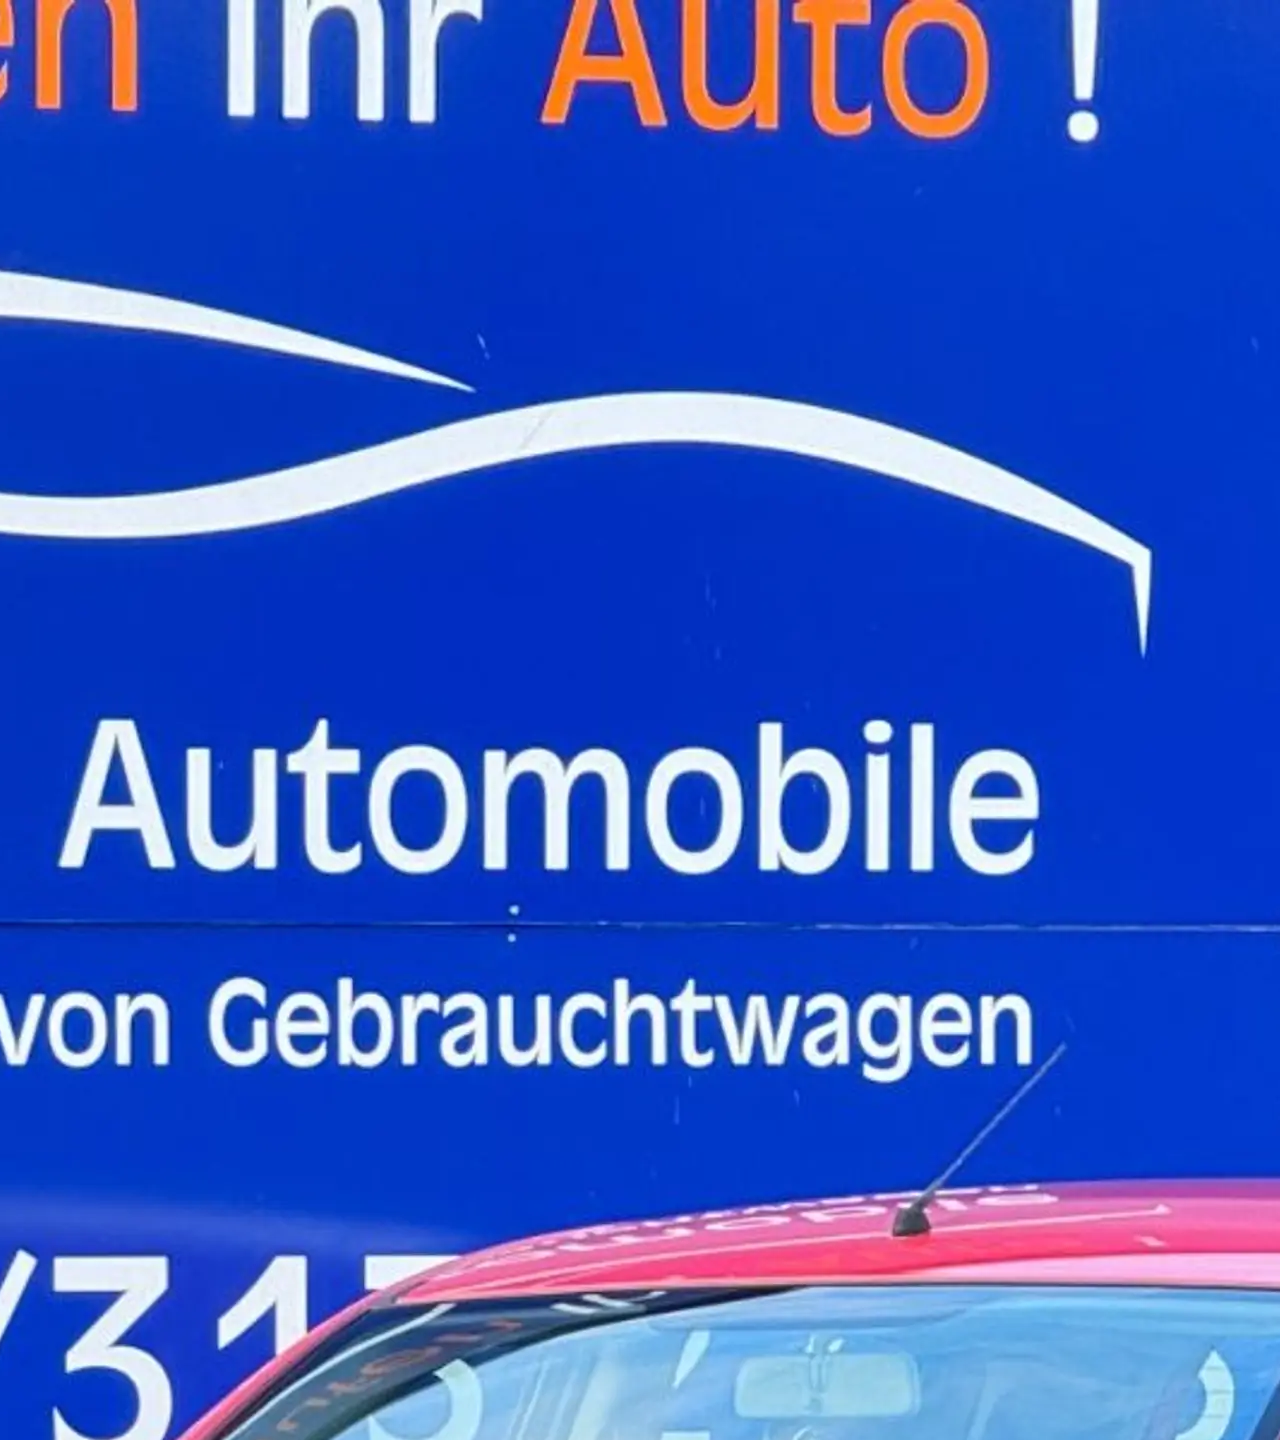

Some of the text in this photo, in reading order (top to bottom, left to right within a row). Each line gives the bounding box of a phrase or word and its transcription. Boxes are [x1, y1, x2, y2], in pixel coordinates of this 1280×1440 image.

[227, 0, 484, 124] Ihr
[540, 0, 990, 140] Auto
[58, 718, 1040, 876] Automobile
[208, 976, 1033, 1084] Gebrauchtwagen
